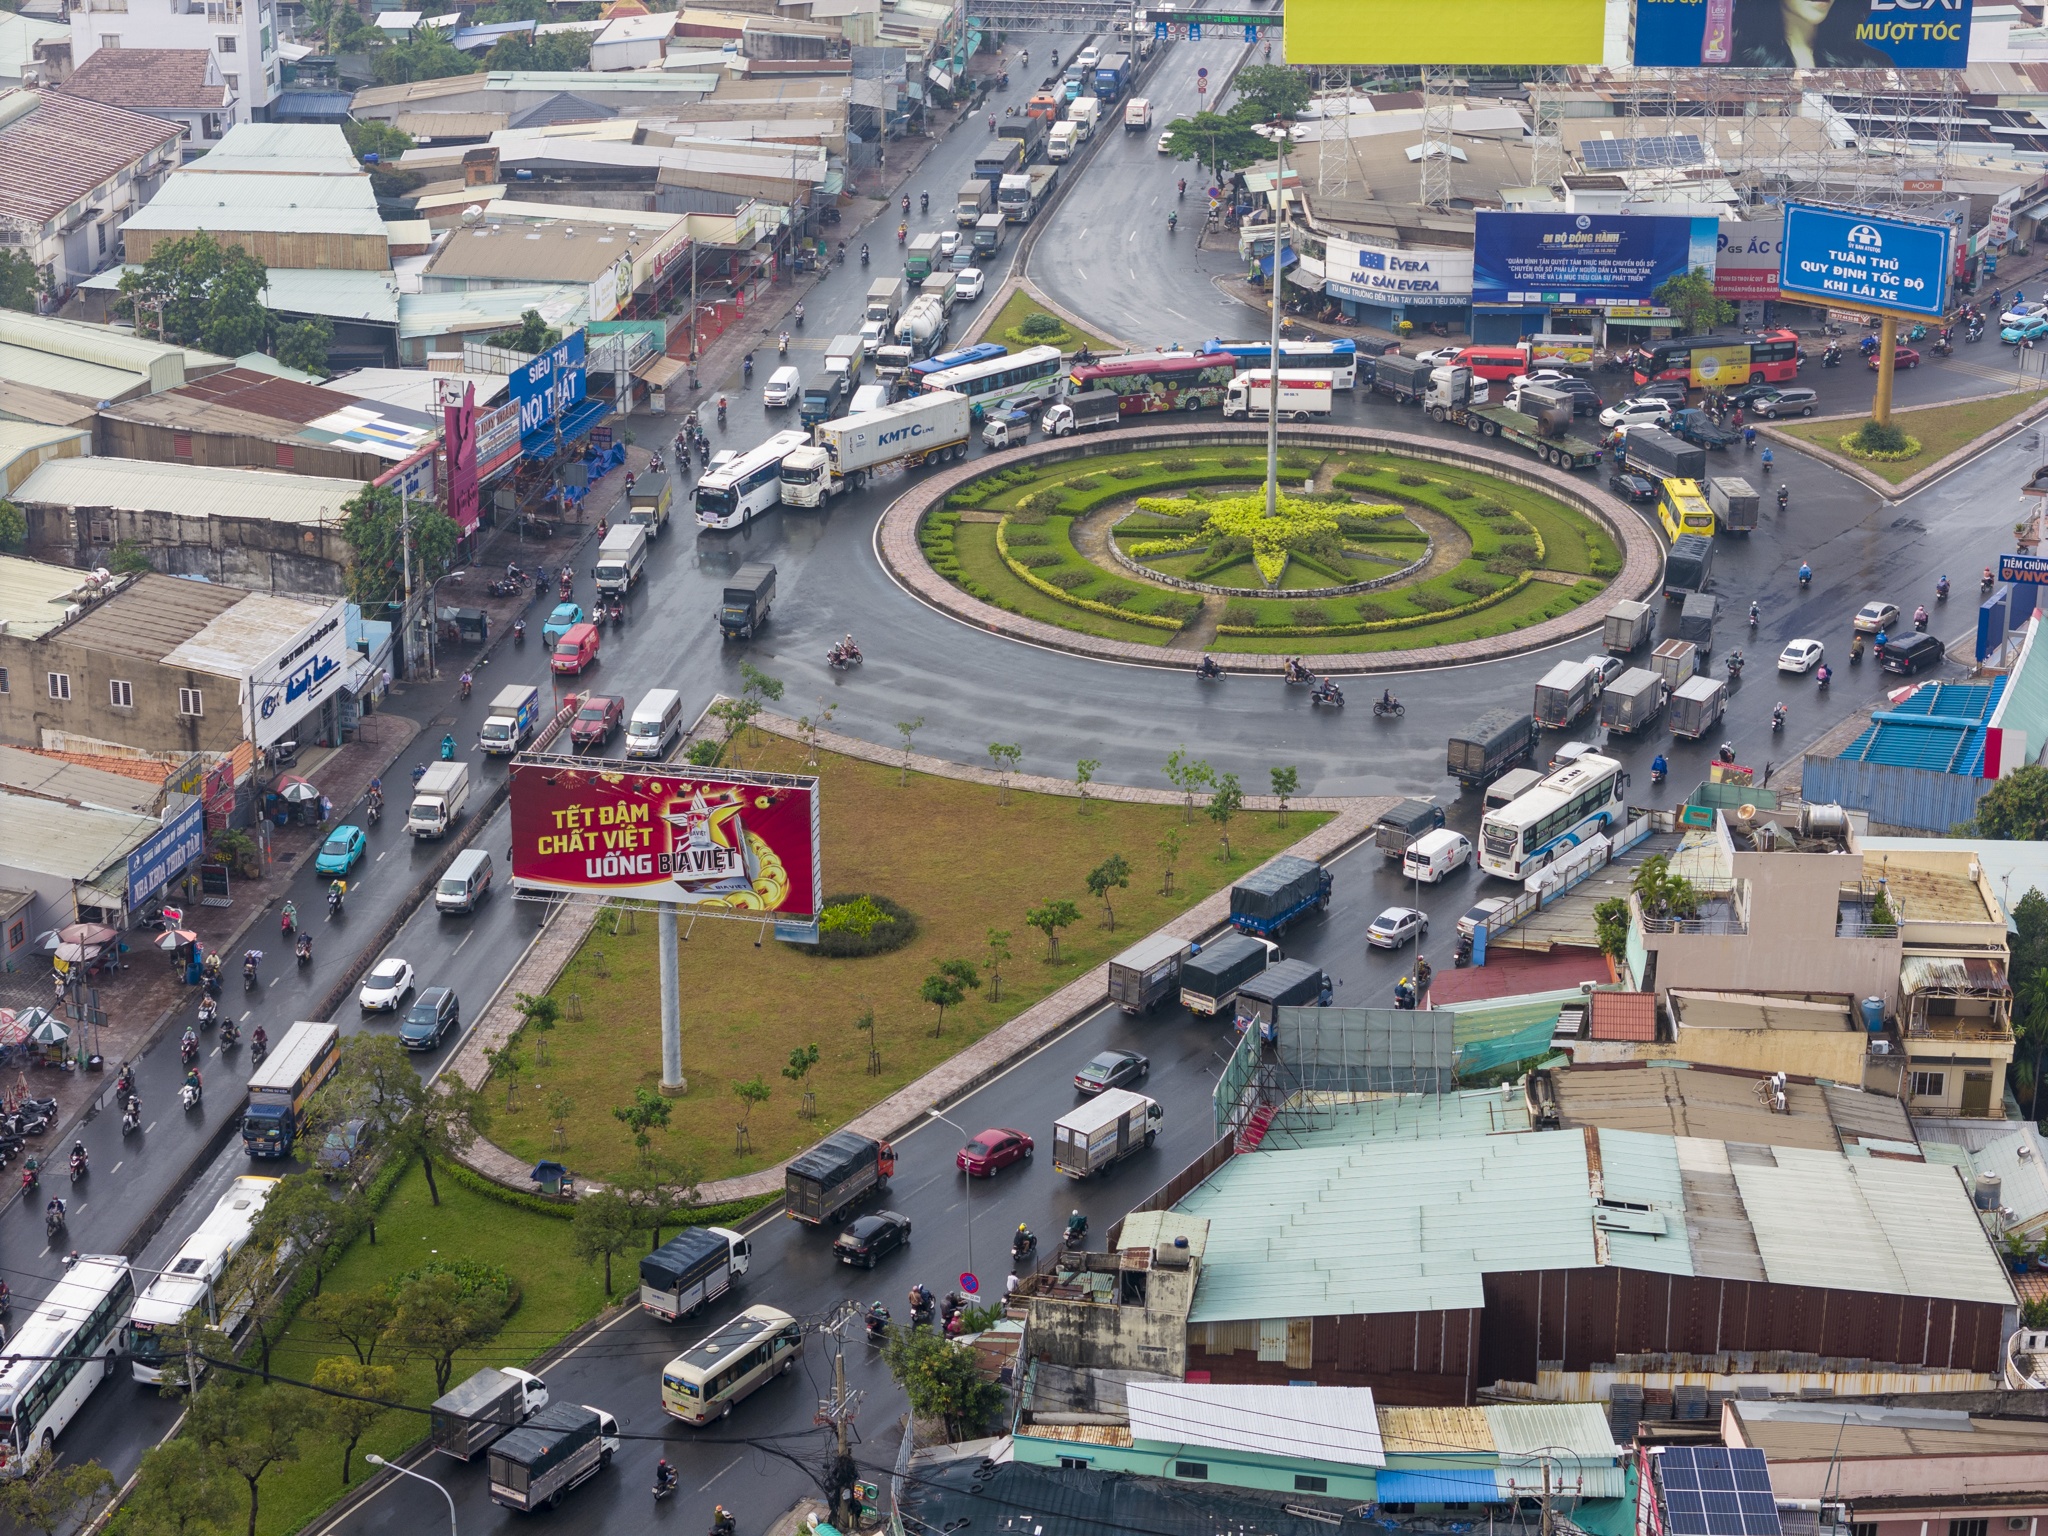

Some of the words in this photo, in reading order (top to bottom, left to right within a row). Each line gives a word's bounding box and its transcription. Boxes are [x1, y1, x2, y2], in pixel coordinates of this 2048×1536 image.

[1856, 21, 1918, 44] MƯỢT
[1921, 20, 1962, 40] TÓC
[1912, 182, 1934, 190] MOON
[1543, 234, 1554, 242] ĐI
[1554, 232, 1568, 244] BỘ
[1568, 231, 1593, 243] ĐỒNG
[1595, 232, 1620, 243] HÀNH
[1747, 236, 1770, 254] ẮC
[1390, 257, 1430, 272] EVERA
[1829, 250, 1866, 264] TUÂN
[1870, 256, 1899, 270] THỦ
[1350, 272, 1368, 284] HẢI
[1372, 274, 1396, 289] SẢN
[1398, 280, 1439, 291] EVERA
[1801, 260, 1829, 274] QUY
[1833, 266, 1867, 280] ĐỊNH
[1872, 272, 1900, 286] TỐC
[1904, 278, 1924, 291] ĐỘ
[1824, 280, 1848, 292] KHI
[1852, 281, 1875, 297] LÁI
[1879, 289, 1898, 300] XE
[1400, 296, 1412, 304] TAY
[1435, 296, 1448, 304] TIÊU
[1450, 296, 1467, 305] DÙNG
[529, 357, 550, 384] SIÊU
[522, 394, 542, 432] NỘI
[879, 424, 922, 446] KMTC
[2003, 558, 2022, 568] TIÊM
[2024, 560, 2048, 571] CHỦN
[2014, 570, 2048, 583] VNVC
[552, 804, 594, 829] TẾT
[599, 800, 649, 828] ĐẬM
[538, 828, 599, 855] CHẤT
[602, 824, 653, 852] VIỆT
[586, 850, 652, 878] UỐNG
[134, 874, 148, 903] NHA
[148, 862, 166, 891] KHOA
